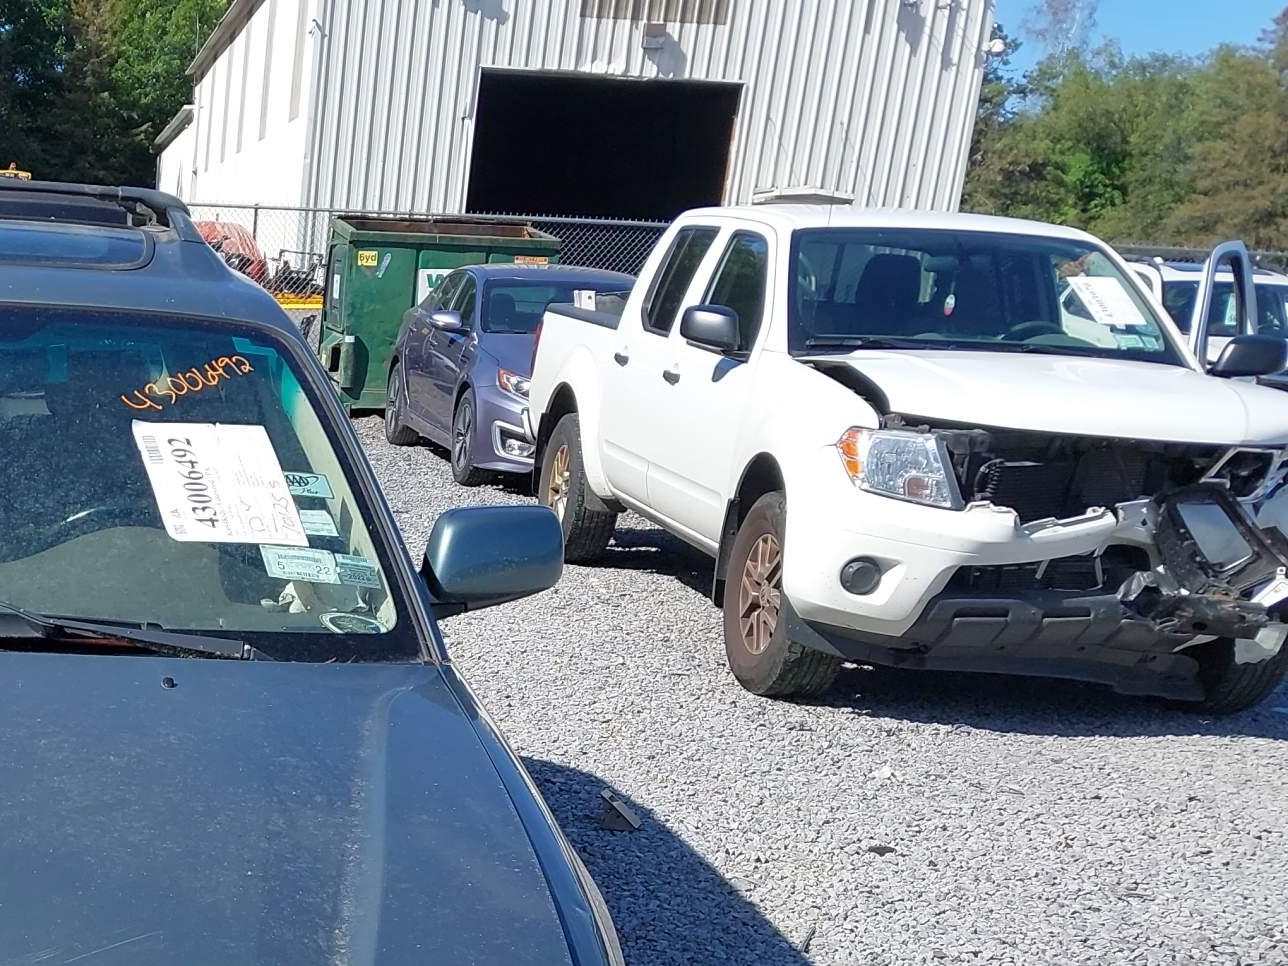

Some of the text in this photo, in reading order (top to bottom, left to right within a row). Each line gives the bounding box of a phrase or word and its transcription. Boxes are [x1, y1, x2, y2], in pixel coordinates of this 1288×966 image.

[120, 355, 255, 411] 43006492
[167, 438, 218, 528] 43006492
[276, 560, 286, 570] 5
[315, 565, 332, 576] 22
